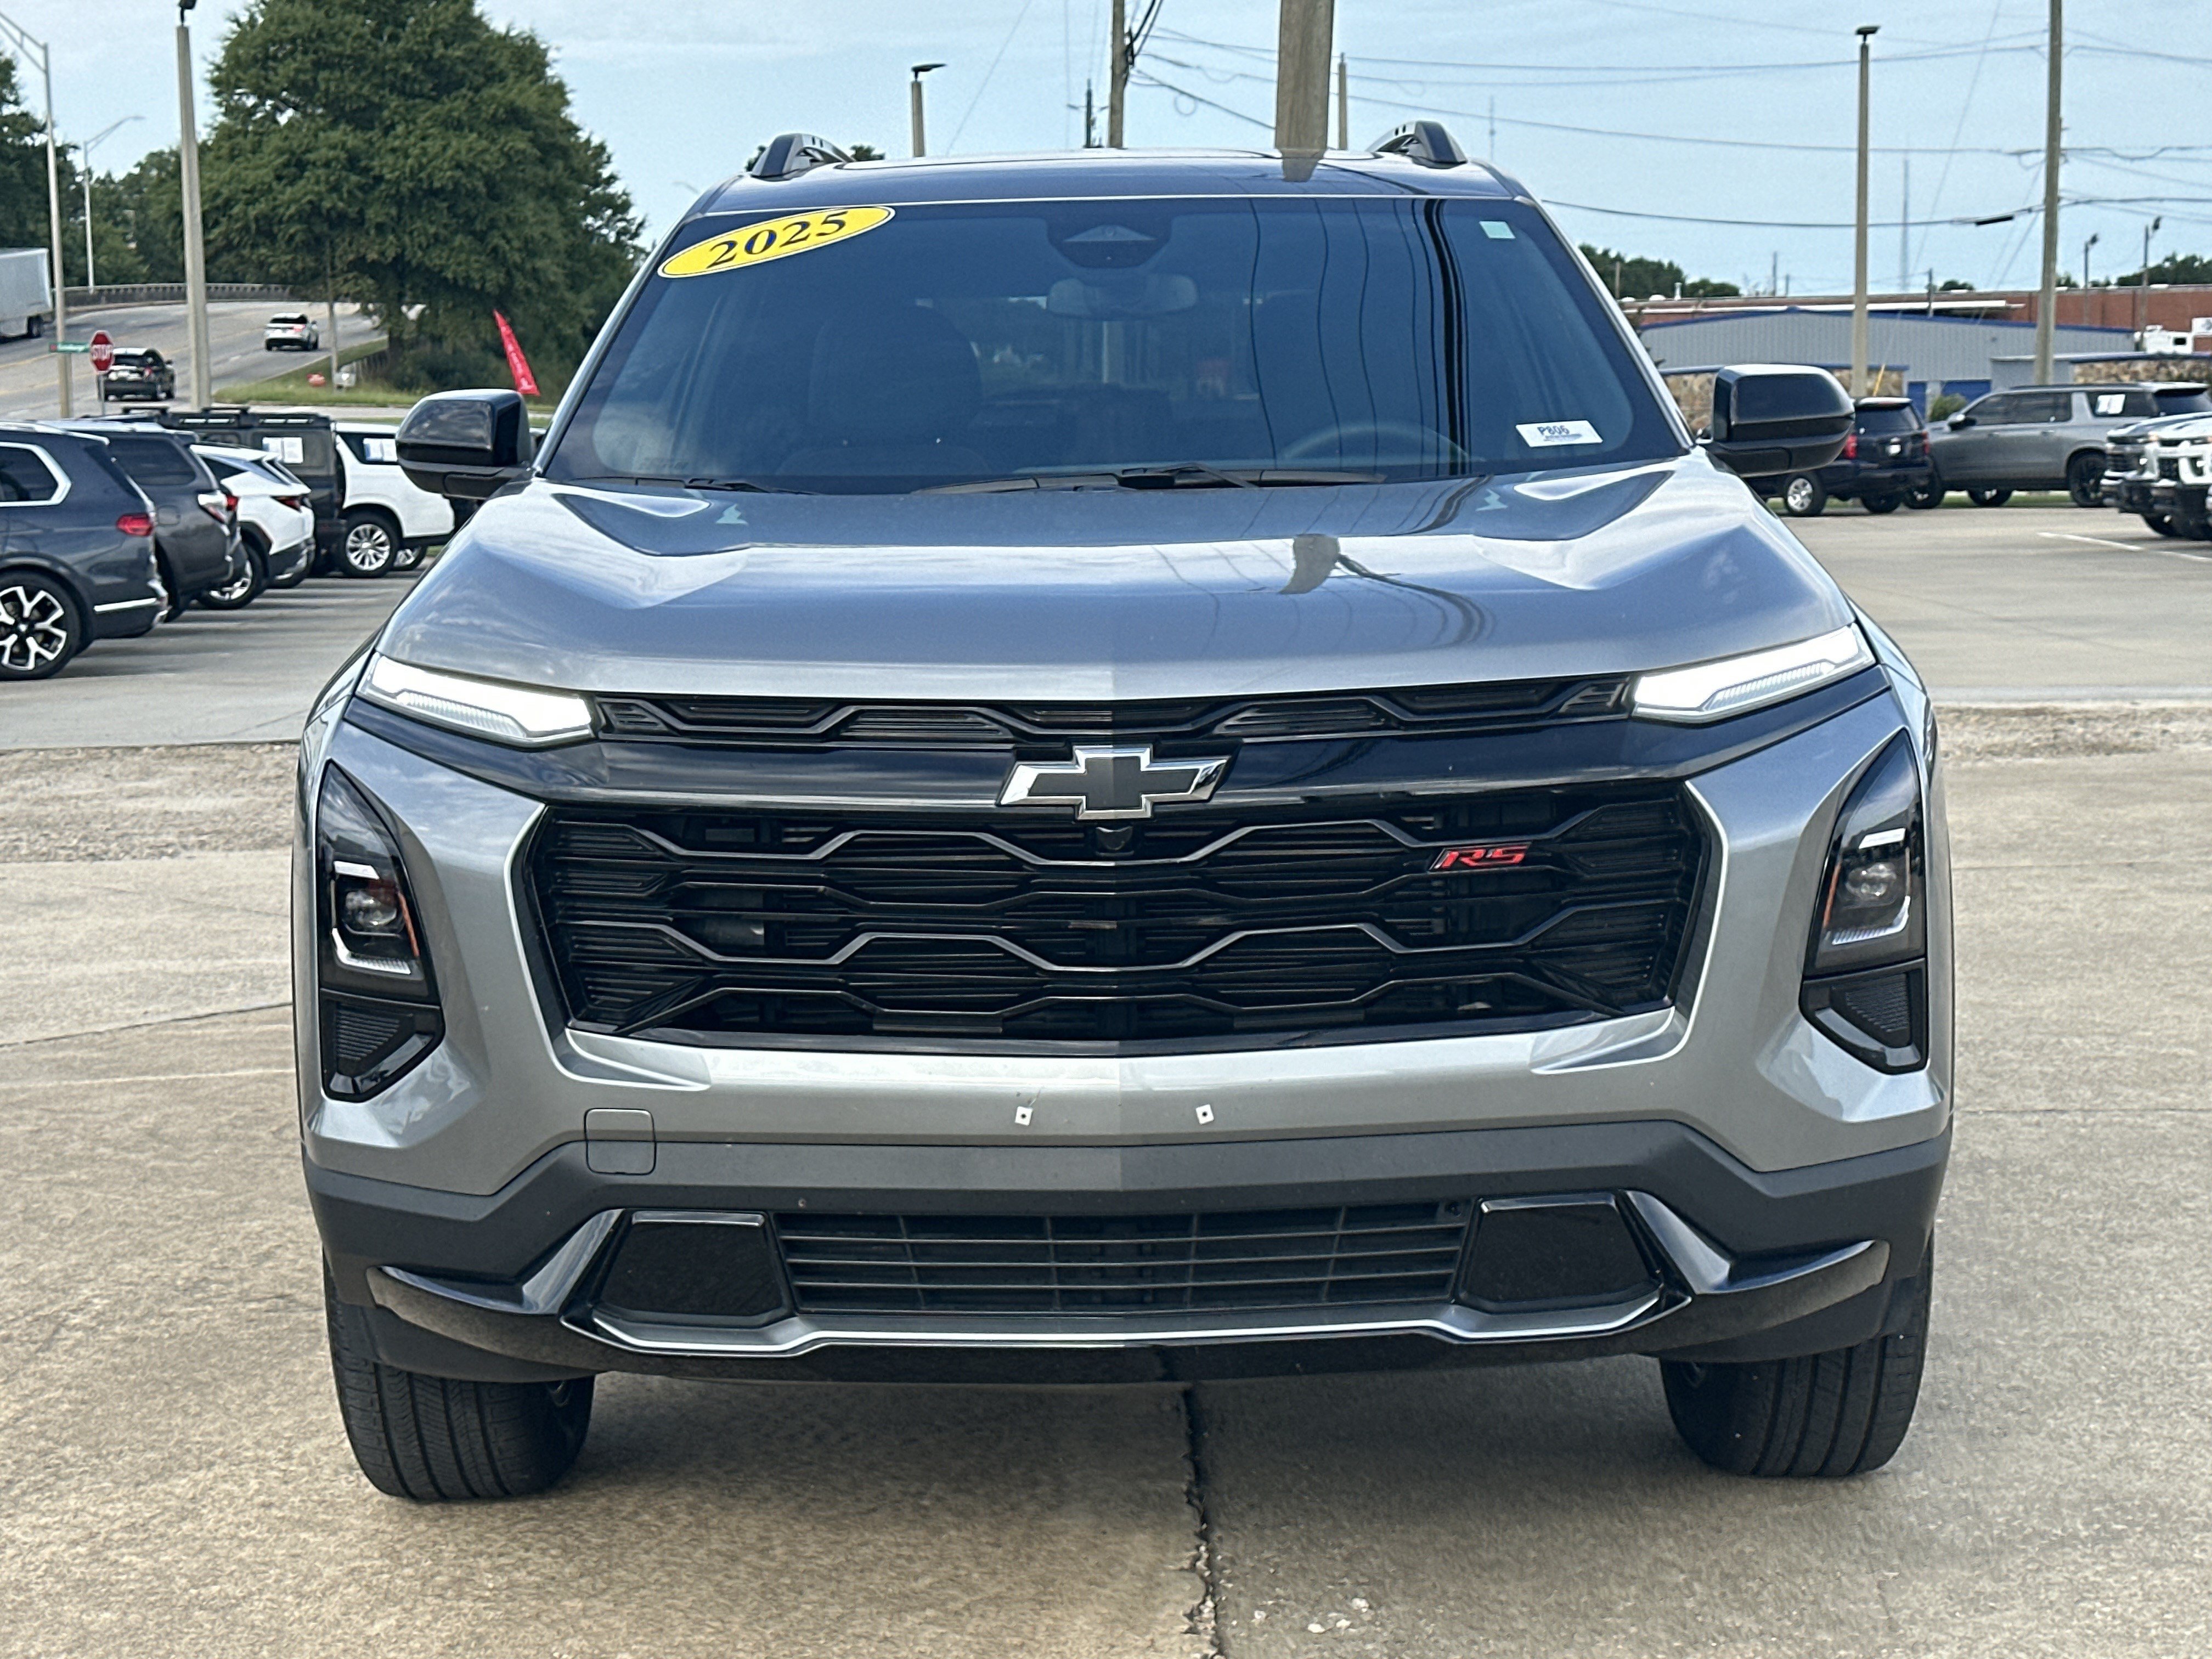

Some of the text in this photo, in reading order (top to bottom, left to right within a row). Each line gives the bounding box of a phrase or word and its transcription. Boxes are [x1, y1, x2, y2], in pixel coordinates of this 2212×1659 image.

[706, 211, 848, 269] 2025
[92, 344, 113, 360] STOP
[1432, 844, 1529, 870] RS
